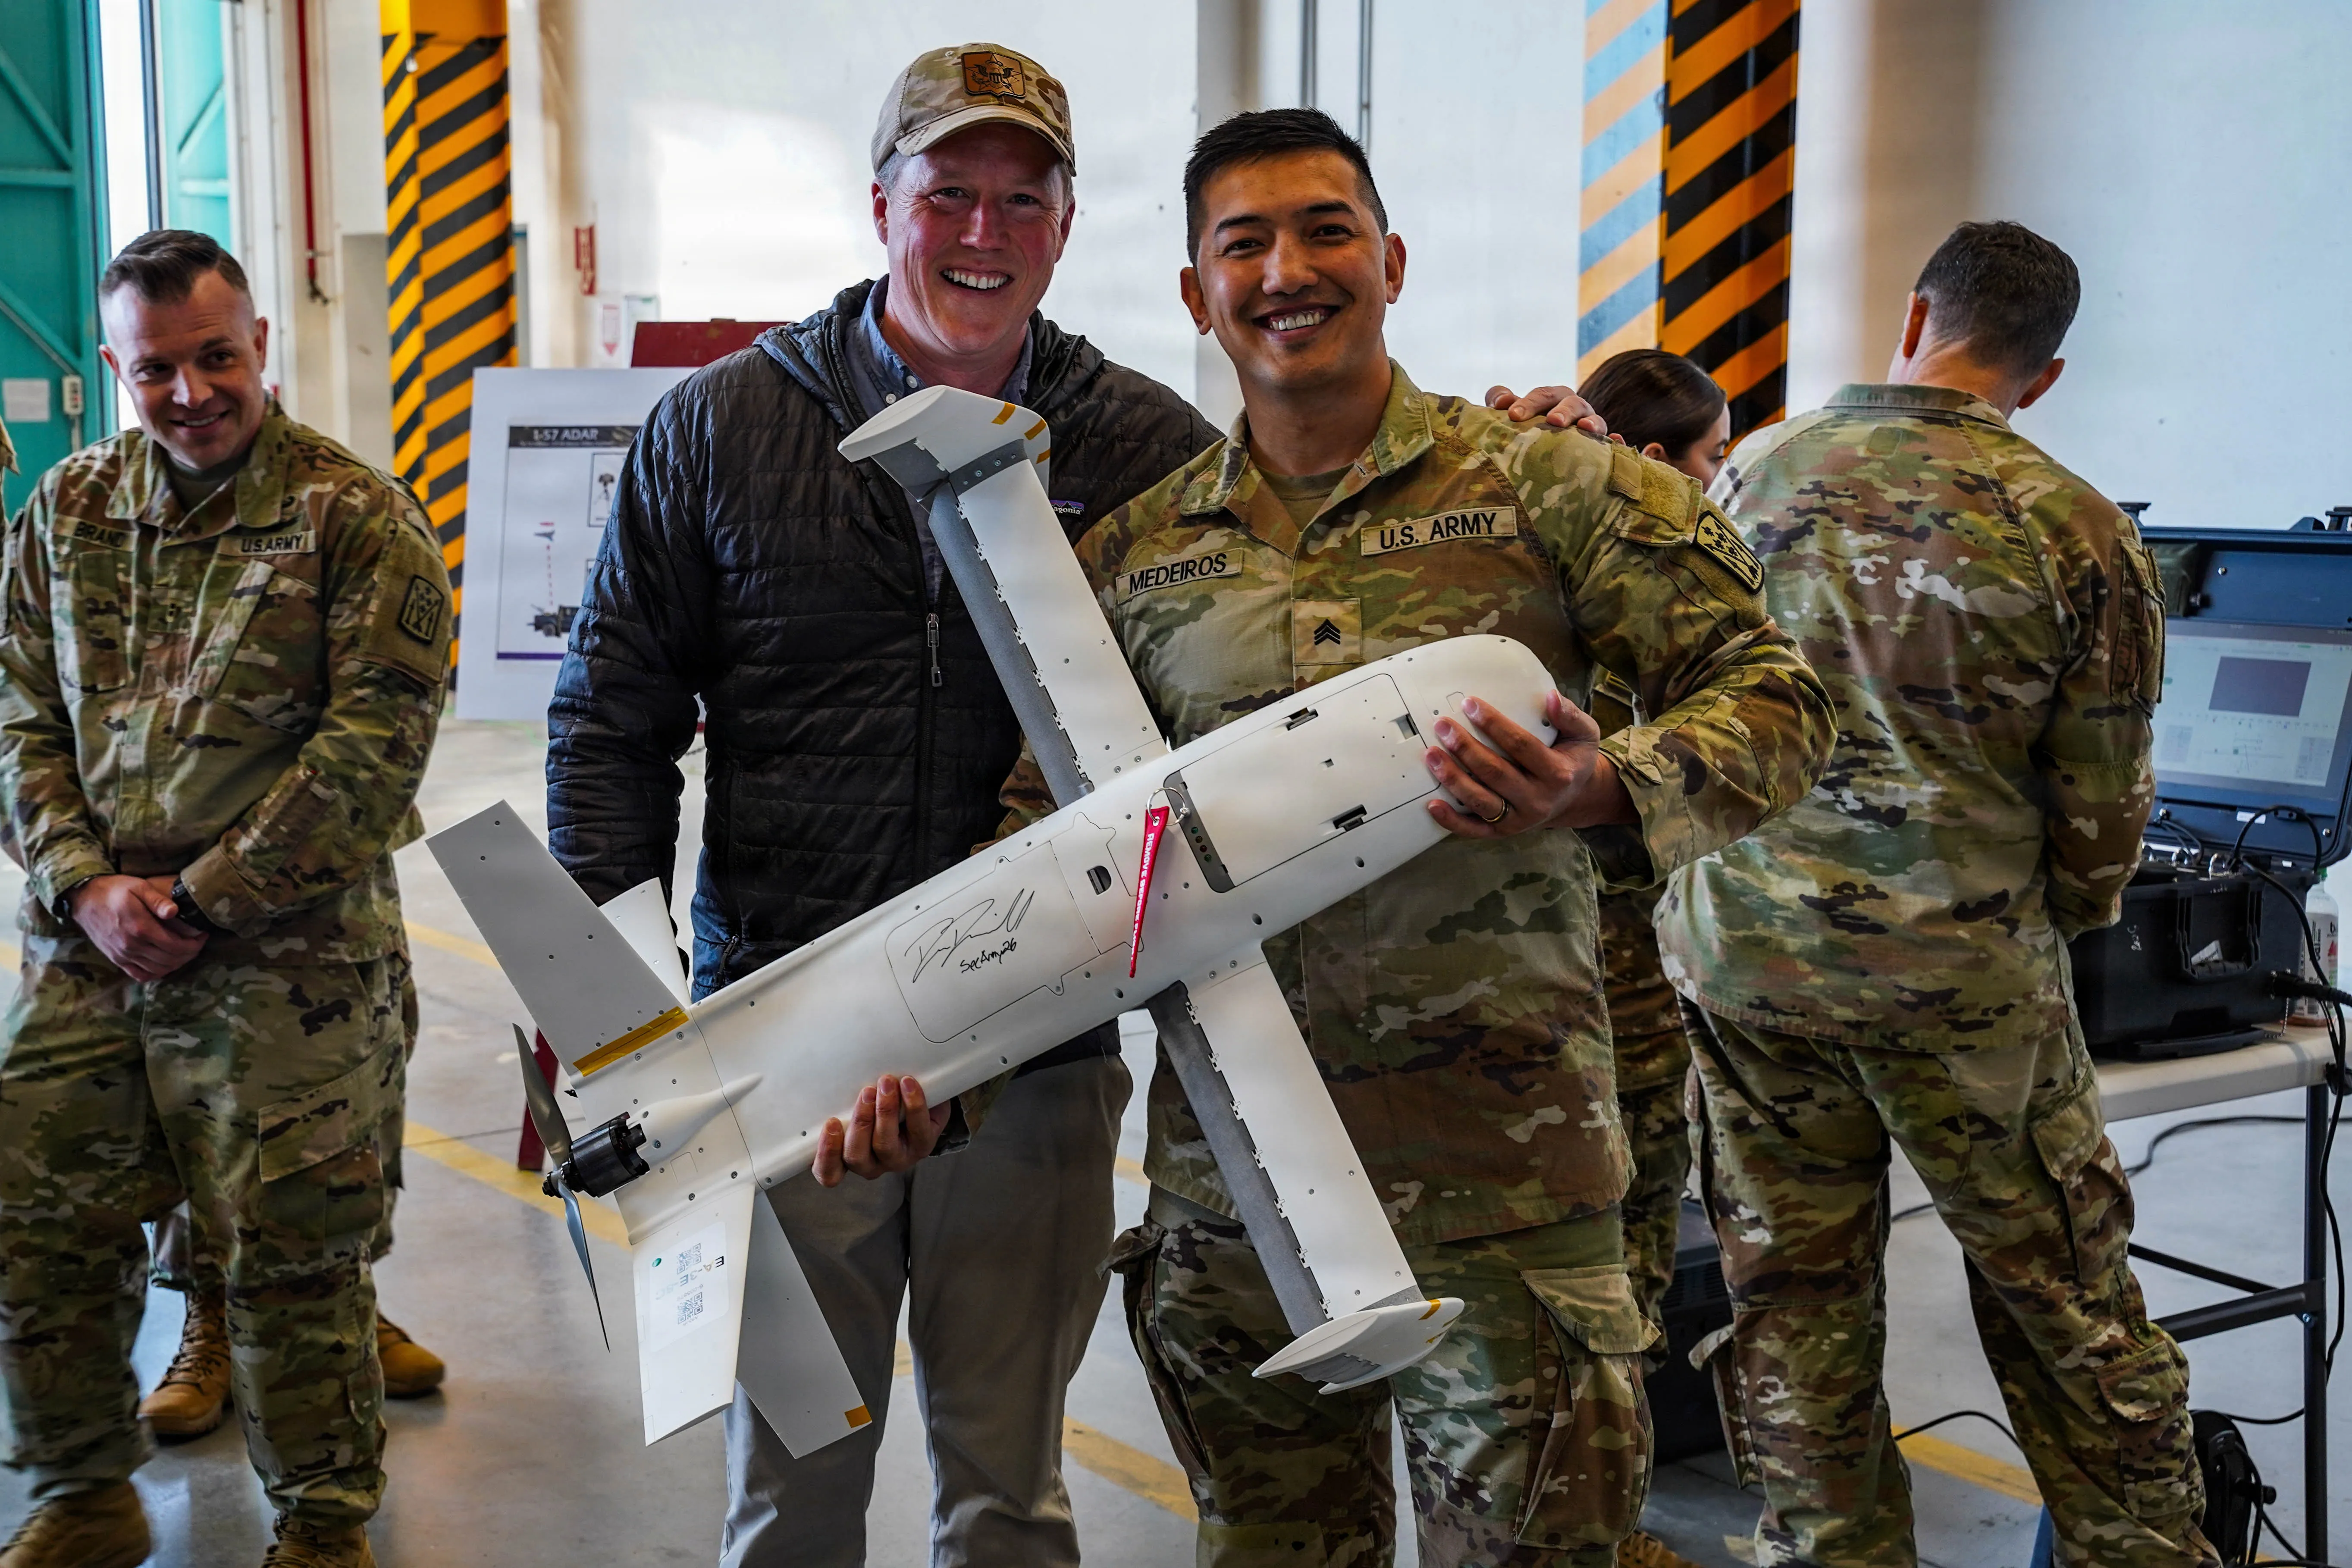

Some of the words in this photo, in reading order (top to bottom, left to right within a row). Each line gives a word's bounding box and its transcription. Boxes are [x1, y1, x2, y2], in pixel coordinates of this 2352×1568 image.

[561, 428, 599, 441] ADAR
[1054, 506, 1081, 515] agonia
[264, 534, 303, 552] ARMY
[1379, 525, 1419, 550] U.S.
[1429, 513, 1497, 541] ARMY
[1129, 553, 1227, 594] MEDEIROS
[1141, 833, 1155, 878] REMOVE
